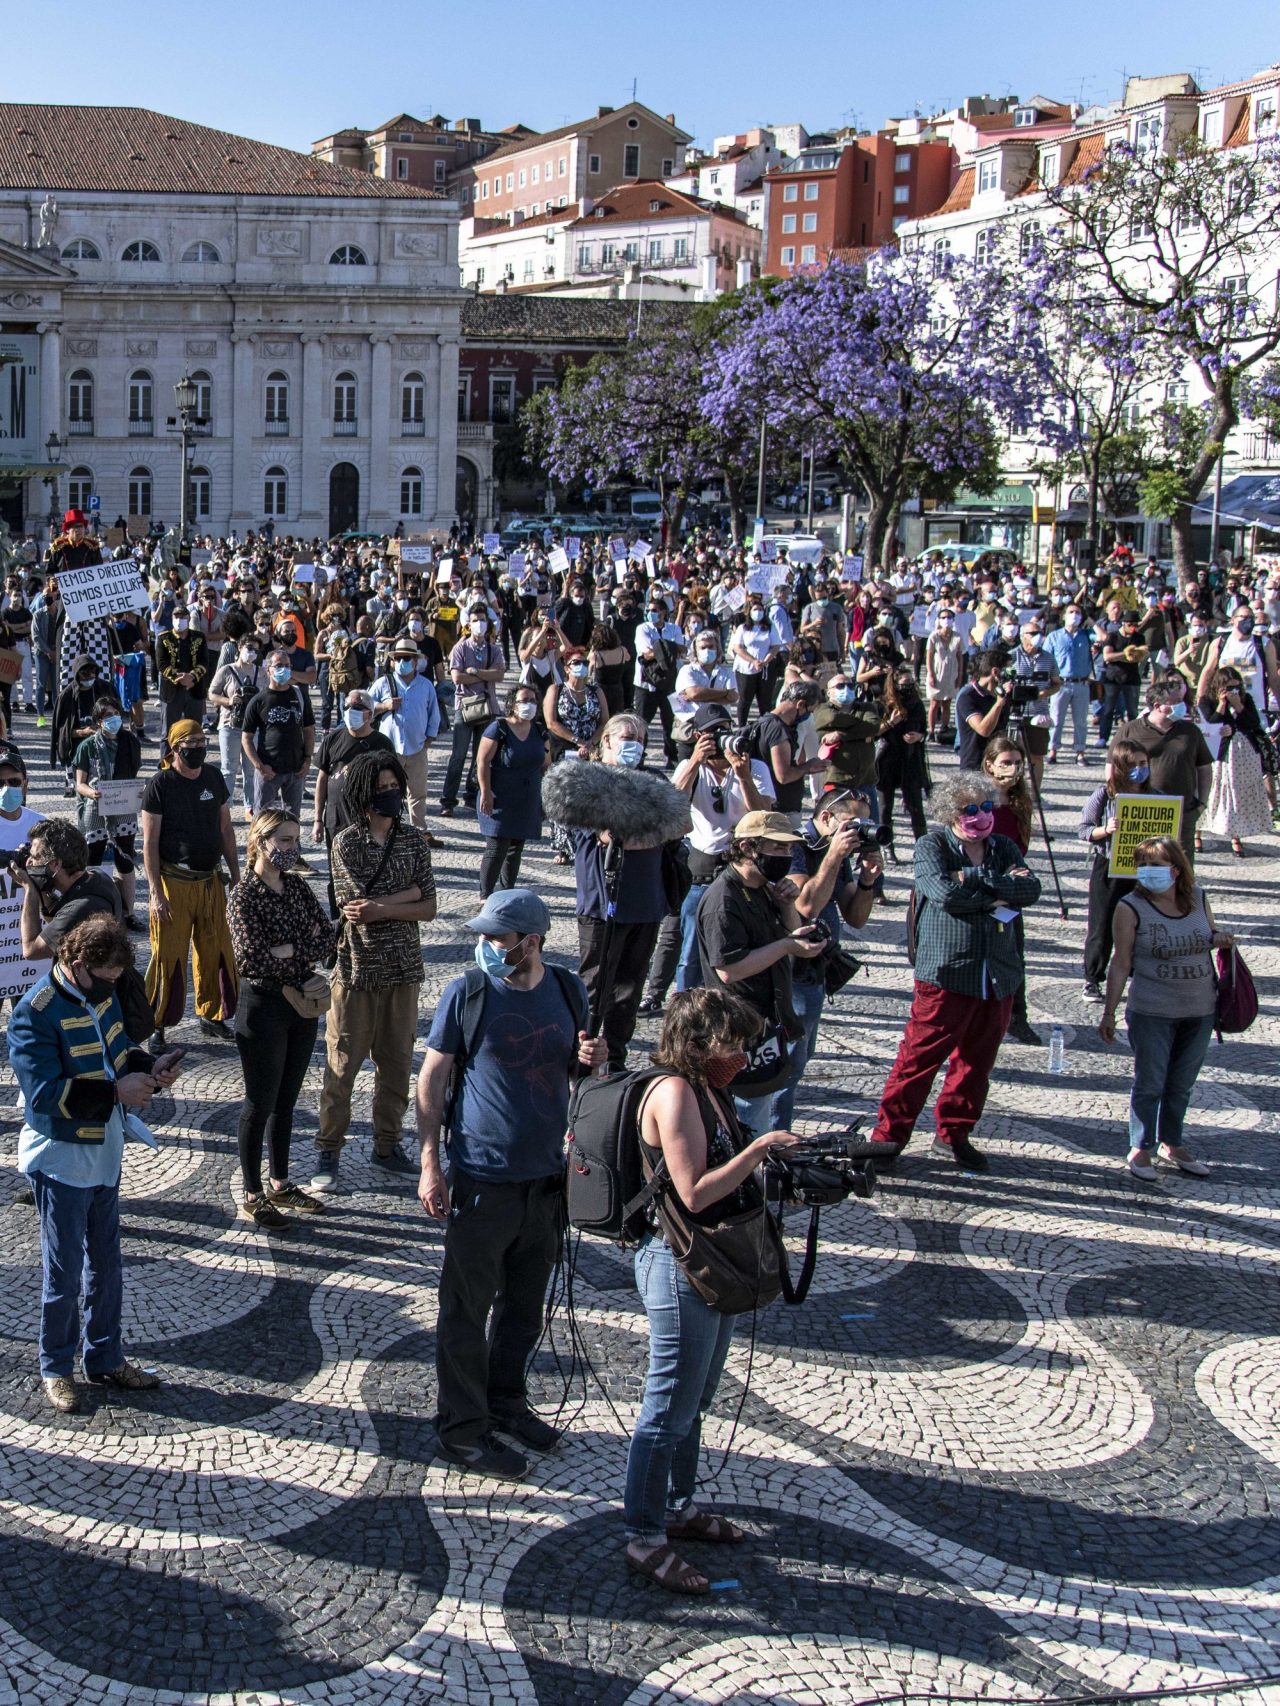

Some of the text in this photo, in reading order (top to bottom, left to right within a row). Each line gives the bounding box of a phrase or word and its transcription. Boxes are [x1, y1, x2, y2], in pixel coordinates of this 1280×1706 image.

[90, 497, 98, 509] P
[58, 561, 139, 588] TEMOS DIREITOS
[62, 577, 144, 606] SOMOS CULTURA
[88, 596, 134, 616] APEAC
[1122, 806, 1175, 820] A CULTURA
[1127, 820, 1140, 832] UM
[1142, 821, 1173, 834] SECTOR
[22, 966, 37, 977] do
